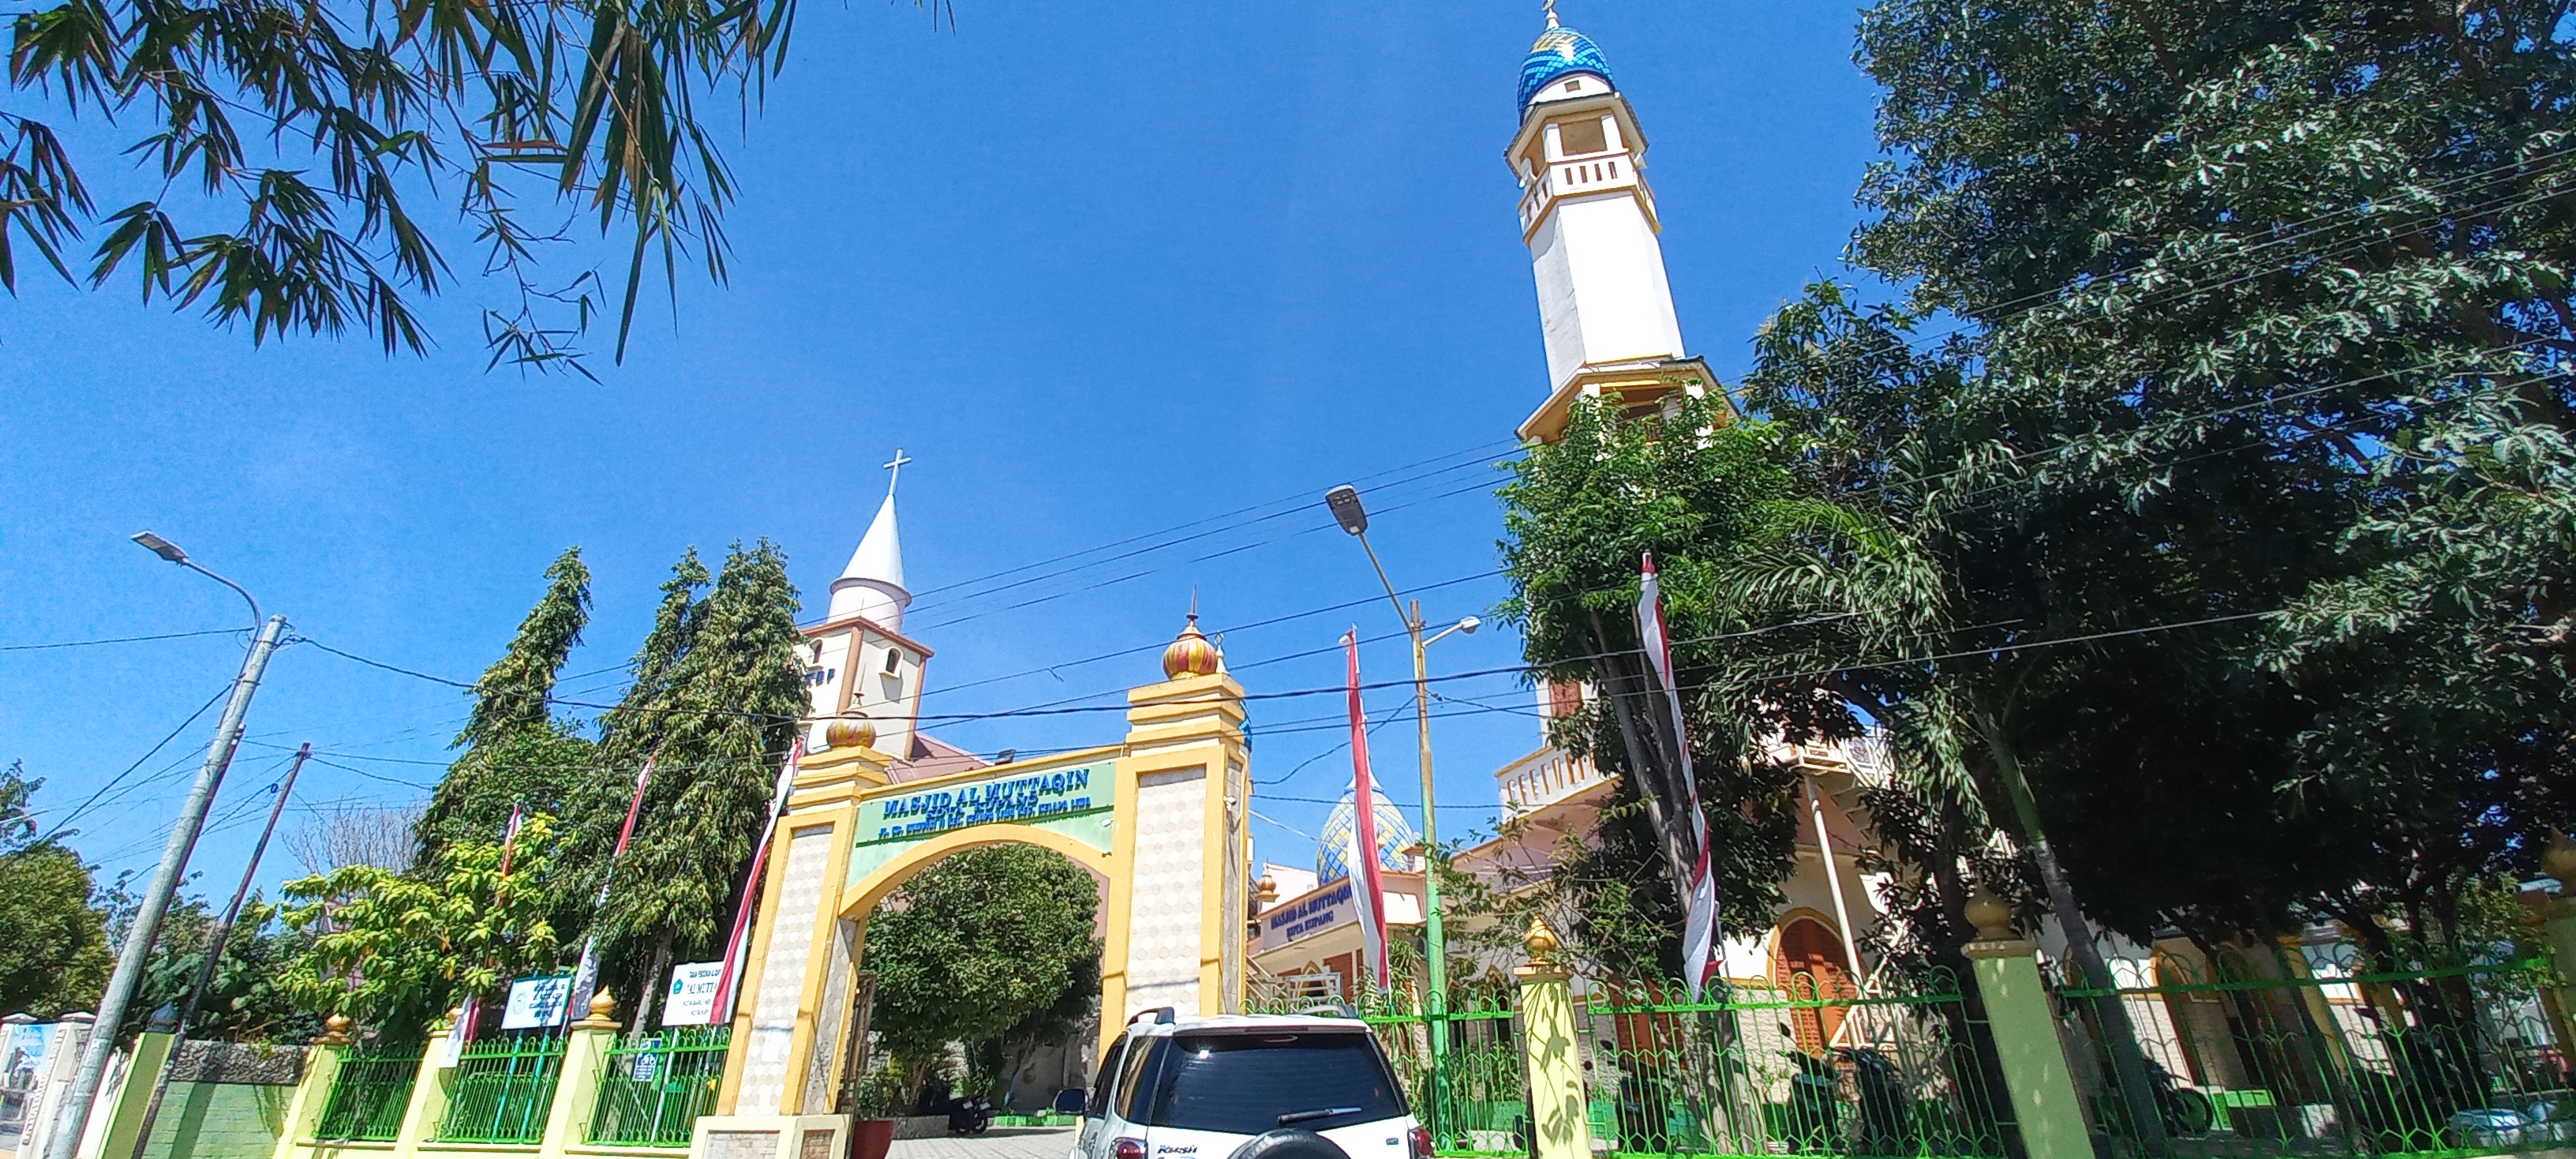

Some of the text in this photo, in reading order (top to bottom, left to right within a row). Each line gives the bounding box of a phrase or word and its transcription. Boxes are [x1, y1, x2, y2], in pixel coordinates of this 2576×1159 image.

[883, 768, 1090, 819] MASJID AL MUTTAQIN
[1271, 908, 1297, 930] MASJID
[1297, 899, 1308, 919] AL
[1305, 910, 1334, 931] KUPANG
